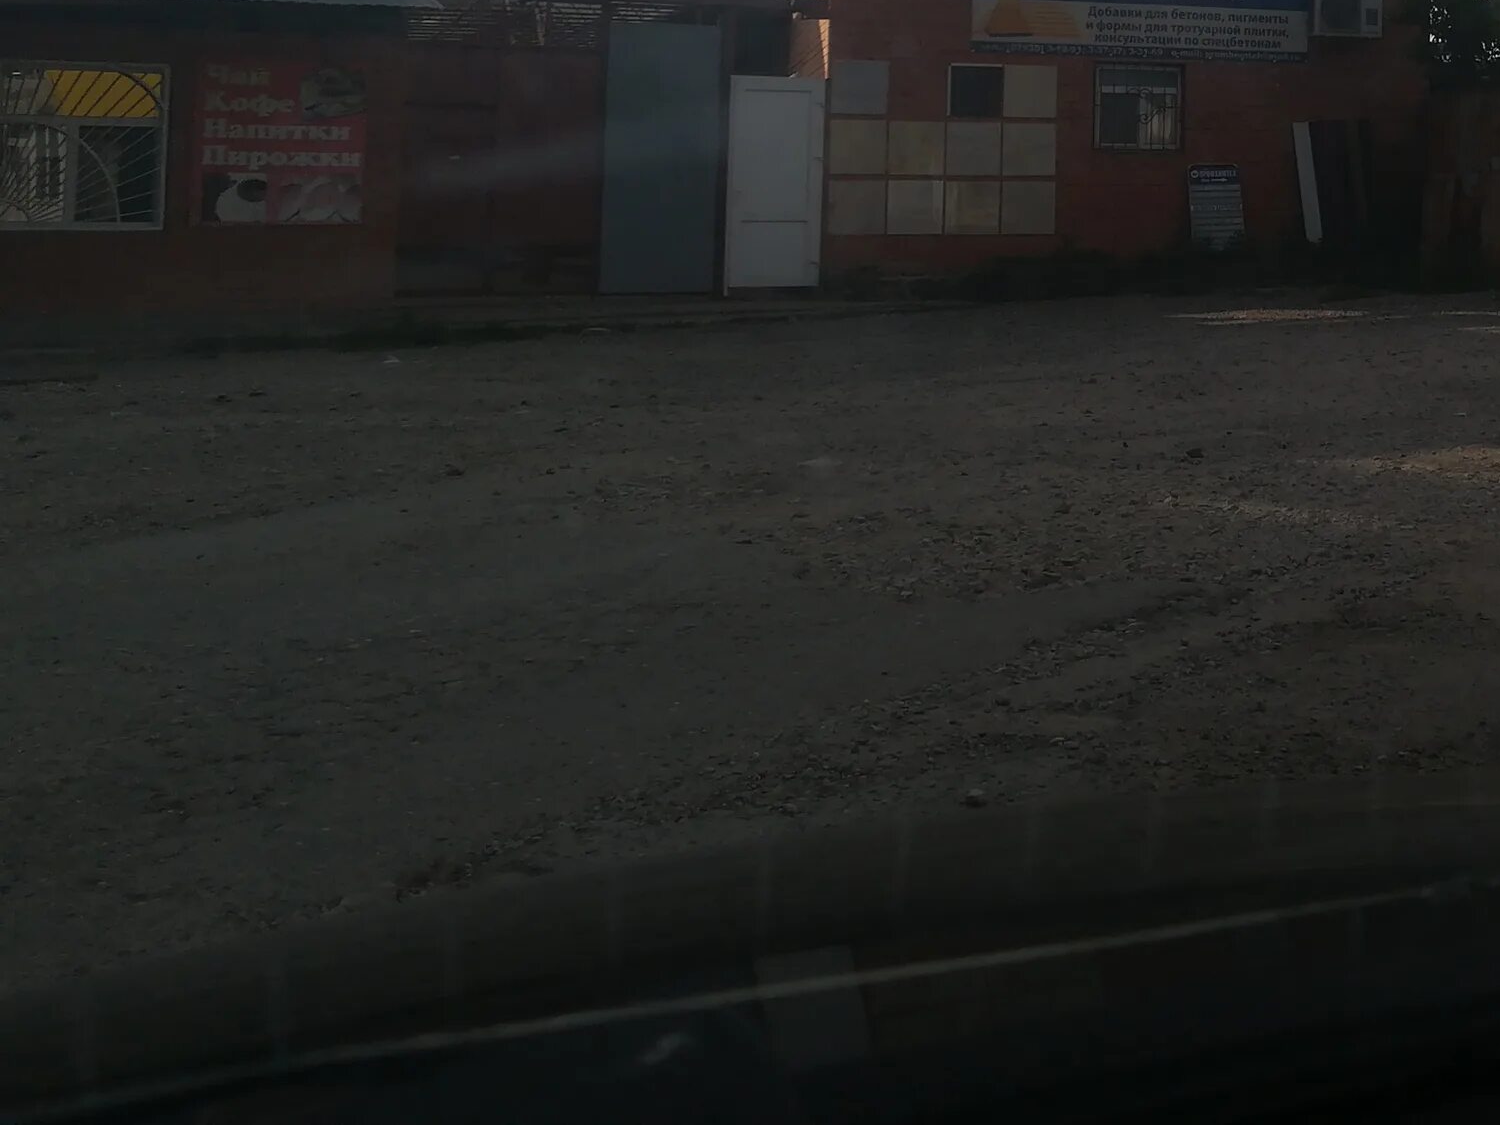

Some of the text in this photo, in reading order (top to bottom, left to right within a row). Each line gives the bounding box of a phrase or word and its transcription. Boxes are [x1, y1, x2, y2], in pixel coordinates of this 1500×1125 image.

[1087, 6, 1142, 20] Добавки
[1145, 10, 1168, 20] для
[1228, 13, 1289, 25] пигменты
[1086, 22, 1094, 30] и
[1096, 19, 1142, 33] формы
[1144, 23, 1168, 33] для
[1171, 24, 1241, 38] тротуарной
[1095, 33, 1281, 49] консультации по спецбетонам
[204, 90, 296, 117] Кофе
[203, 118, 352, 141] Напитки
[202, 145, 362, 170] Пирожки
